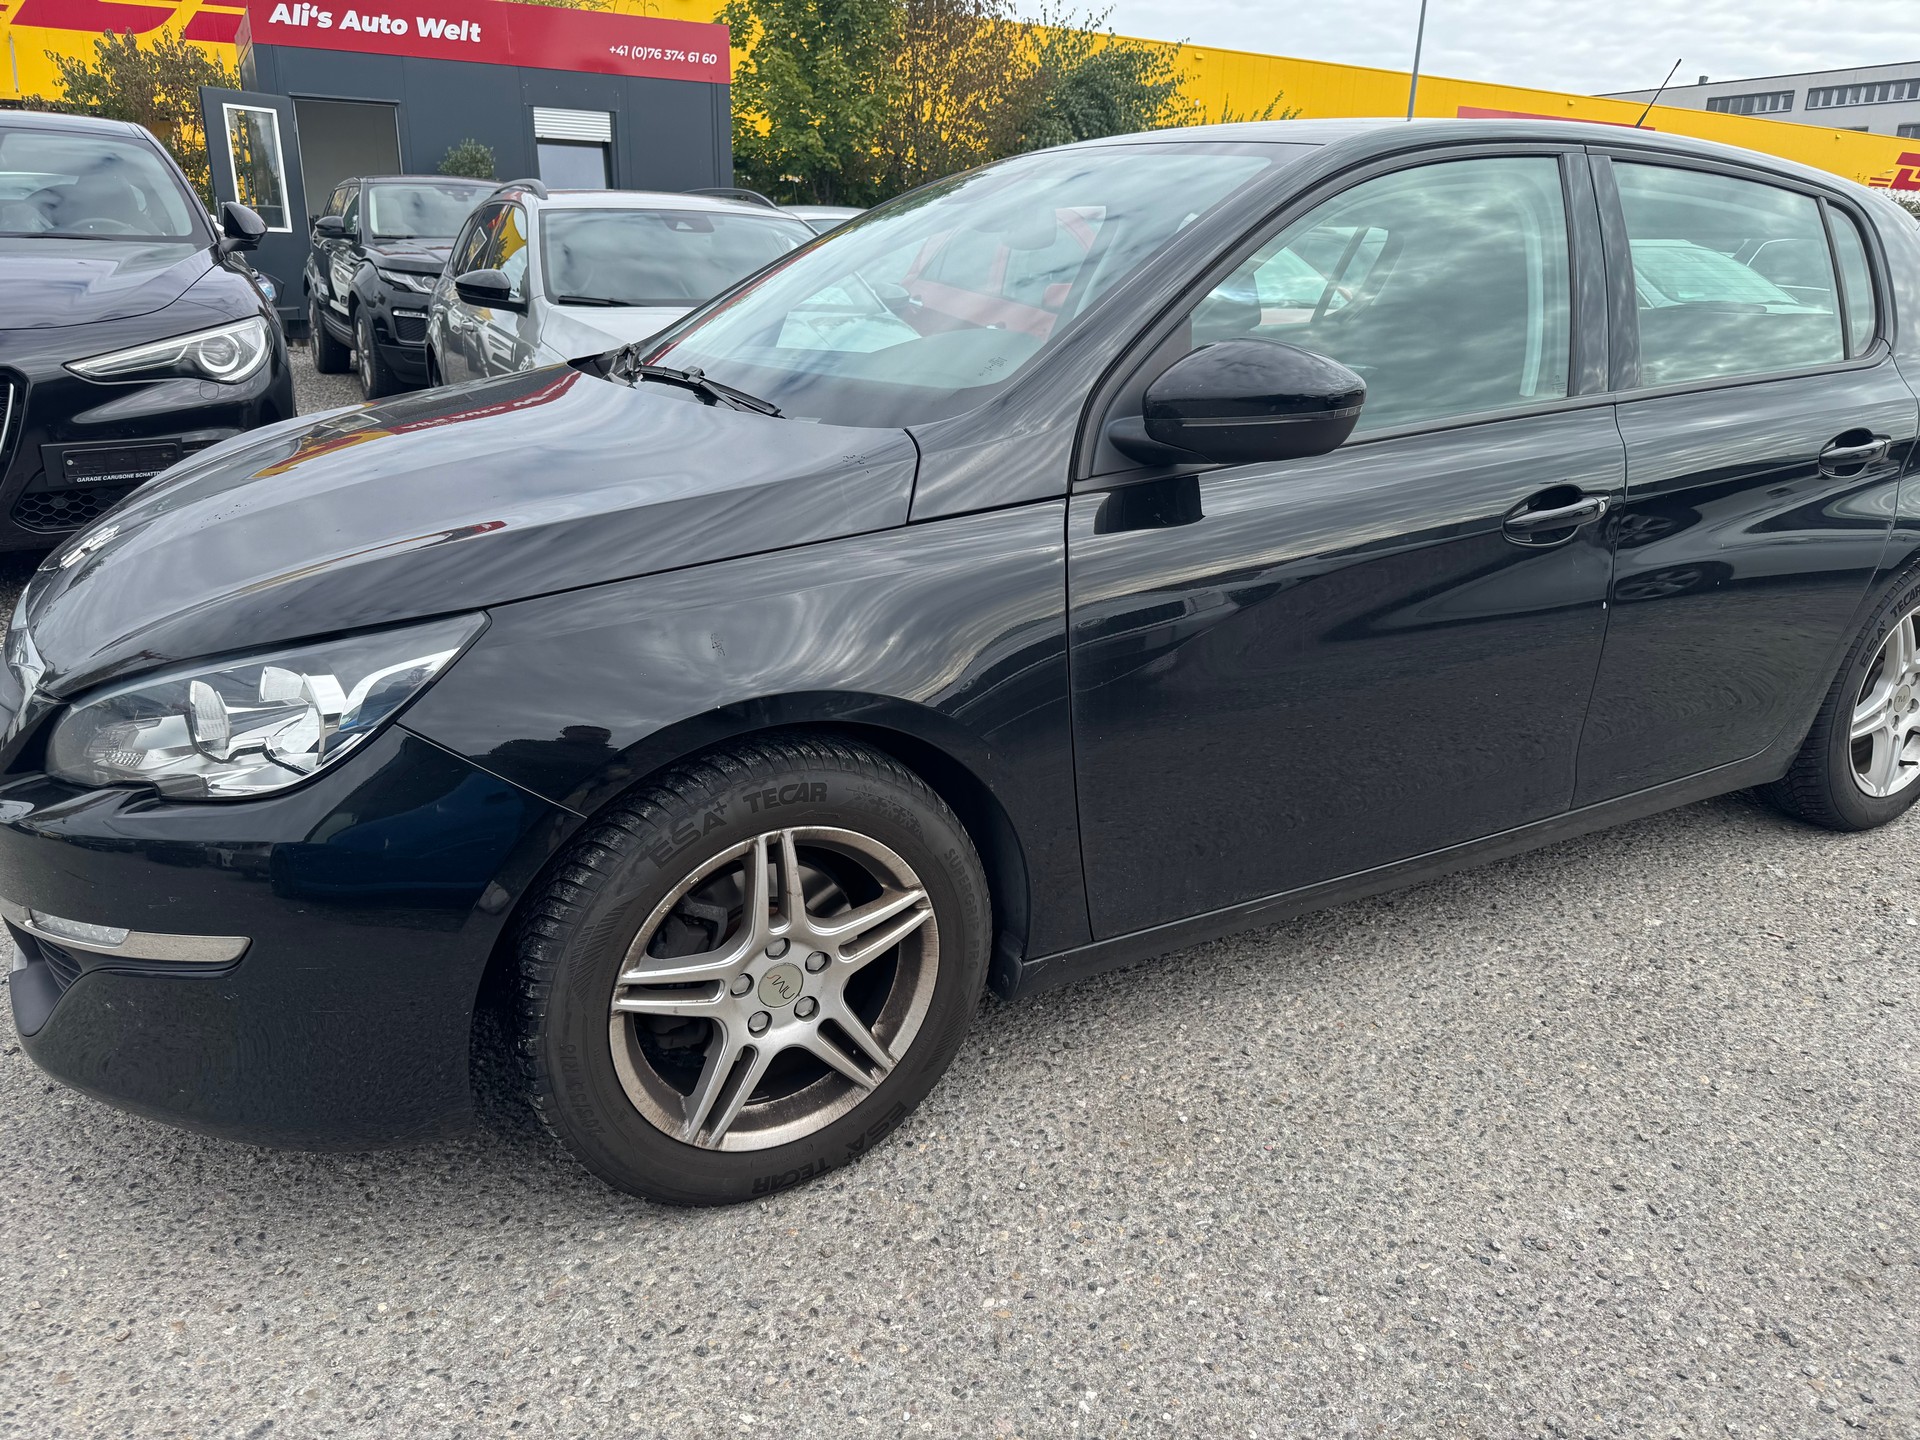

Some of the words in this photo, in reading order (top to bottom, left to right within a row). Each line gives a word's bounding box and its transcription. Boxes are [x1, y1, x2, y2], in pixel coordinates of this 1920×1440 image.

[339, 10, 408, 35] Auto
[416, 17, 481, 42] Welt
[609, 45, 628, 57] +41
[631, 46, 662, 60] (0)76
[664, 49, 685, 61] 374
[687, 52, 699, 63] 61
[702, 53, 717, 64] 60
[77, 475, 102, 483] GARAGE
[743, 782, 828, 814] TECAR
[751, 1157, 831, 1194] TECAR
